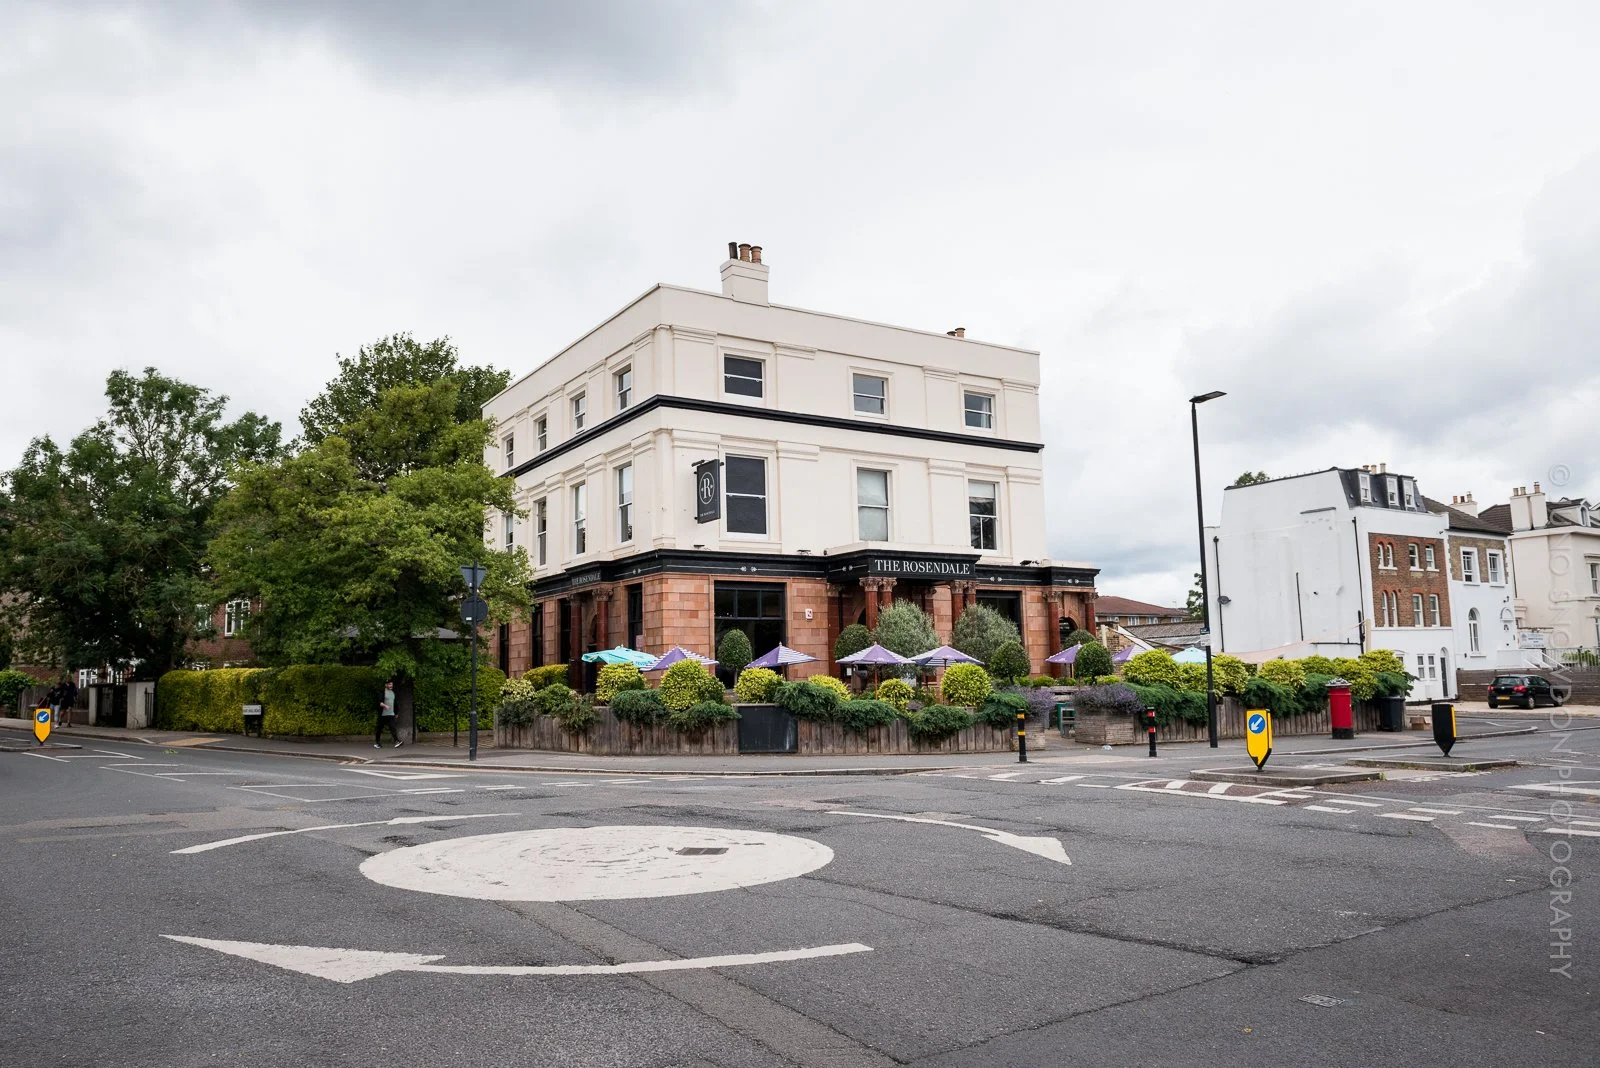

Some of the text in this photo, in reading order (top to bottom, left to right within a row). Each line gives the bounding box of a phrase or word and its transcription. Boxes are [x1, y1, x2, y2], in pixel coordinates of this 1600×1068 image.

[702, 477, 712, 499] R
[874, 559, 970, 575] THE ROSENDALE
